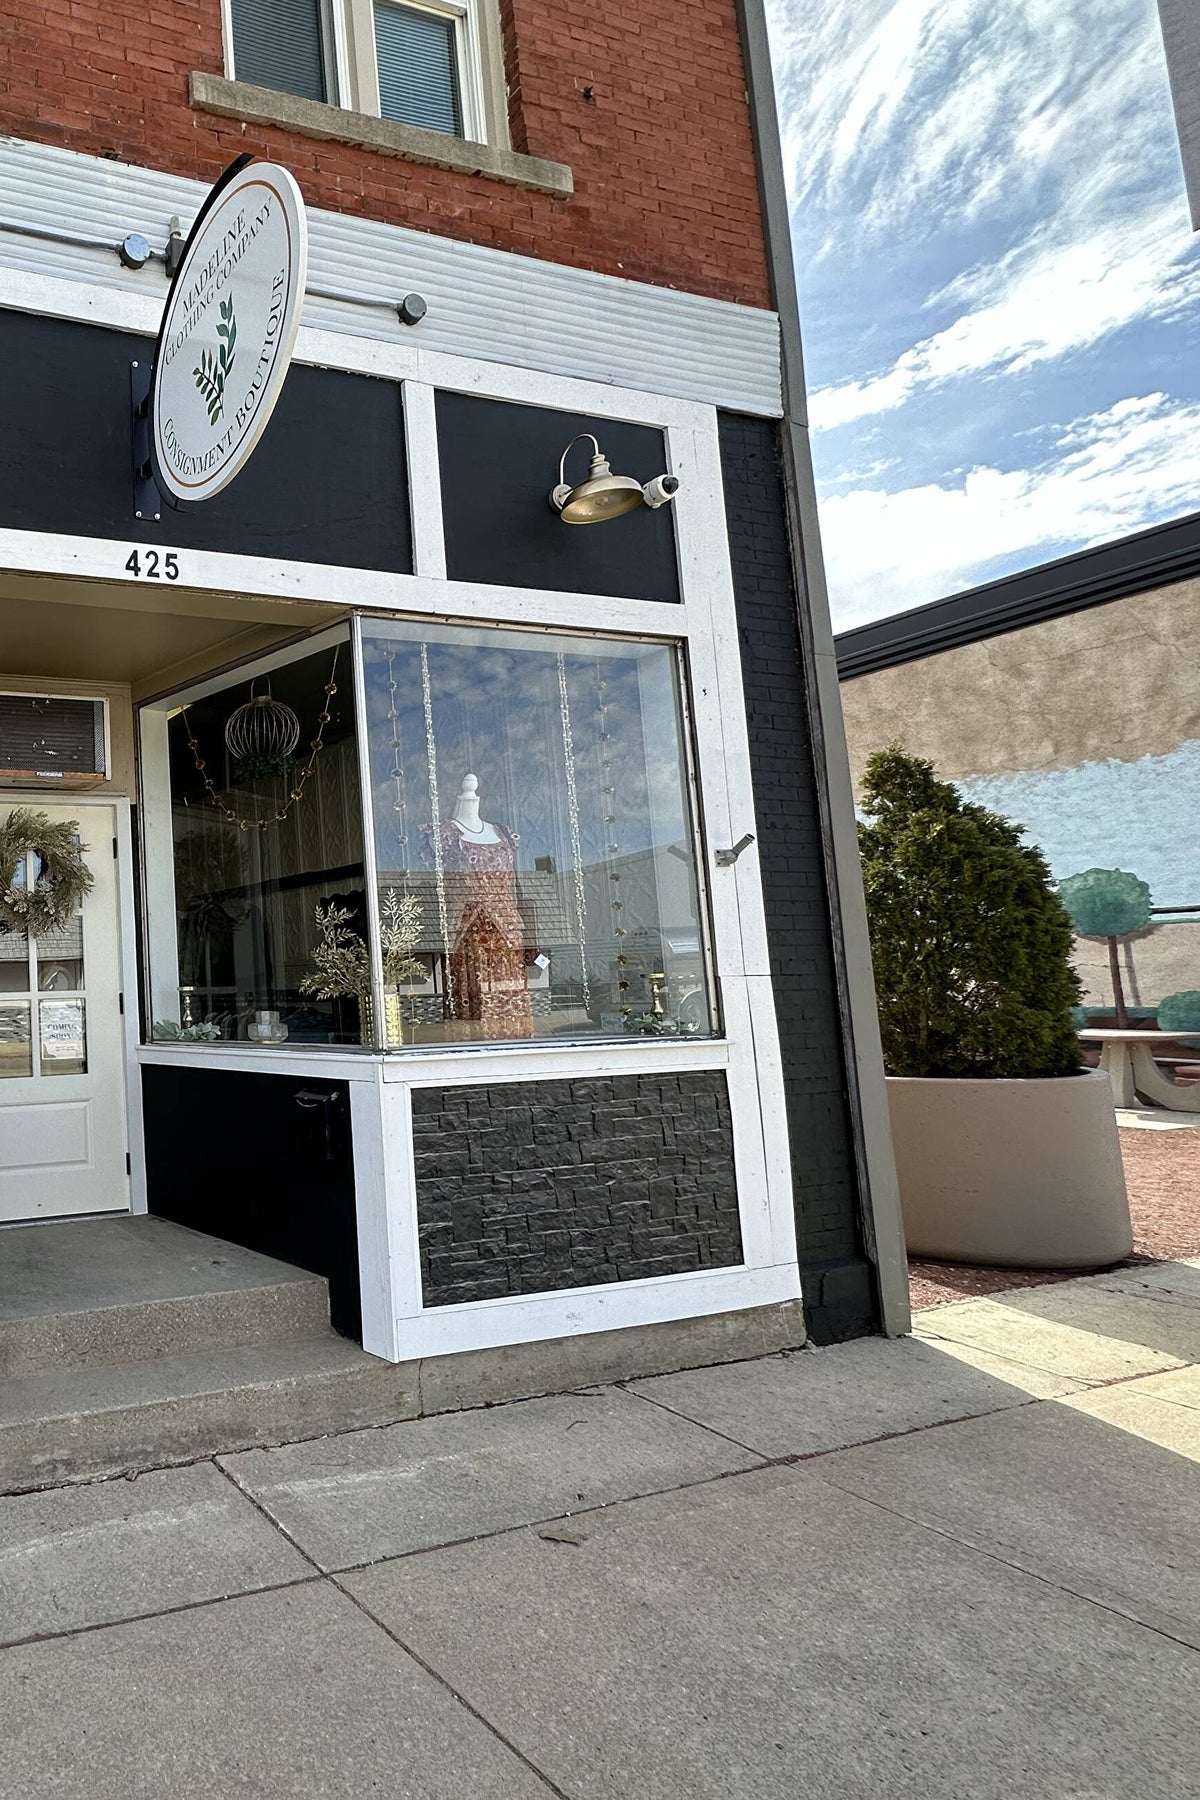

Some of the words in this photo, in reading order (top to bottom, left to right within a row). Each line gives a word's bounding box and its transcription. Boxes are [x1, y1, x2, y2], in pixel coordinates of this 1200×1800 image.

[165, 284, 215, 366] CLOTHING
[216, 196, 273, 291] COMPANY
[182, 208, 246, 318] MADELINE
[163, 418, 234, 476] CONSIGNMENT
[235, 267, 285, 430] BOUTIQUE
[125, 549, 179, 580] 425
